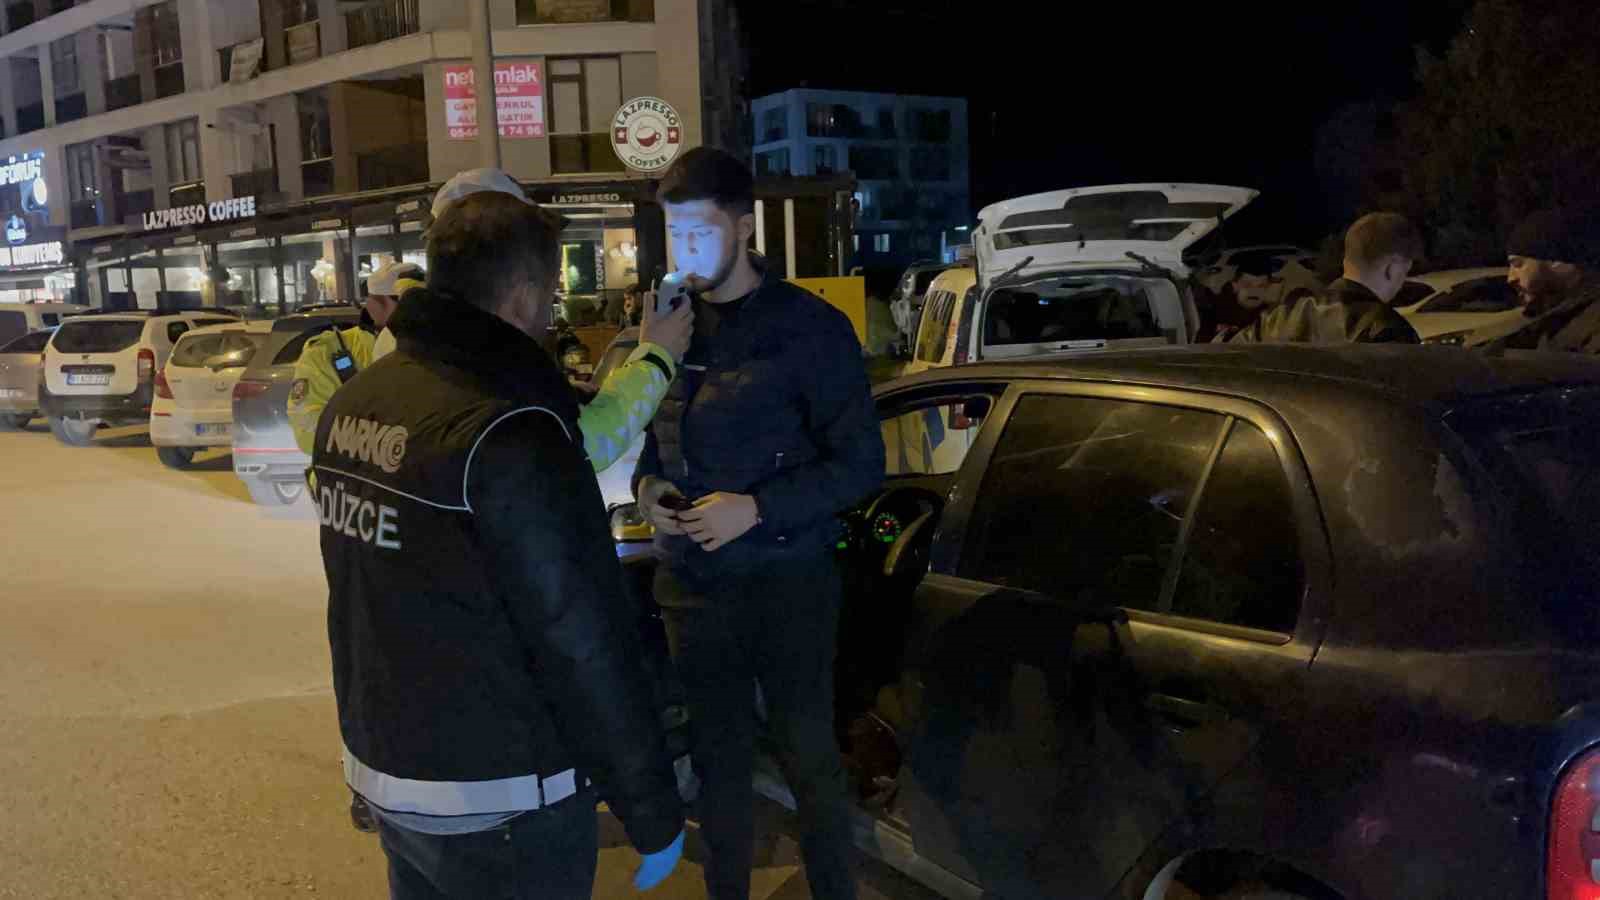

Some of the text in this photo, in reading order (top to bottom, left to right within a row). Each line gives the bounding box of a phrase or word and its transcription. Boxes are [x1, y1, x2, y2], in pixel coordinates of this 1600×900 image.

[494, 65, 537, 83] mlak
[617, 100, 677, 126] LAZPRESSO
[628, 154, 668, 167] COFFEE
[551, 192, 620, 204] LAZPRESSO
[142, 196, 256, 230] LAZPRESSO COFFEE
[319, 481, 402, 550] DÜZCE
